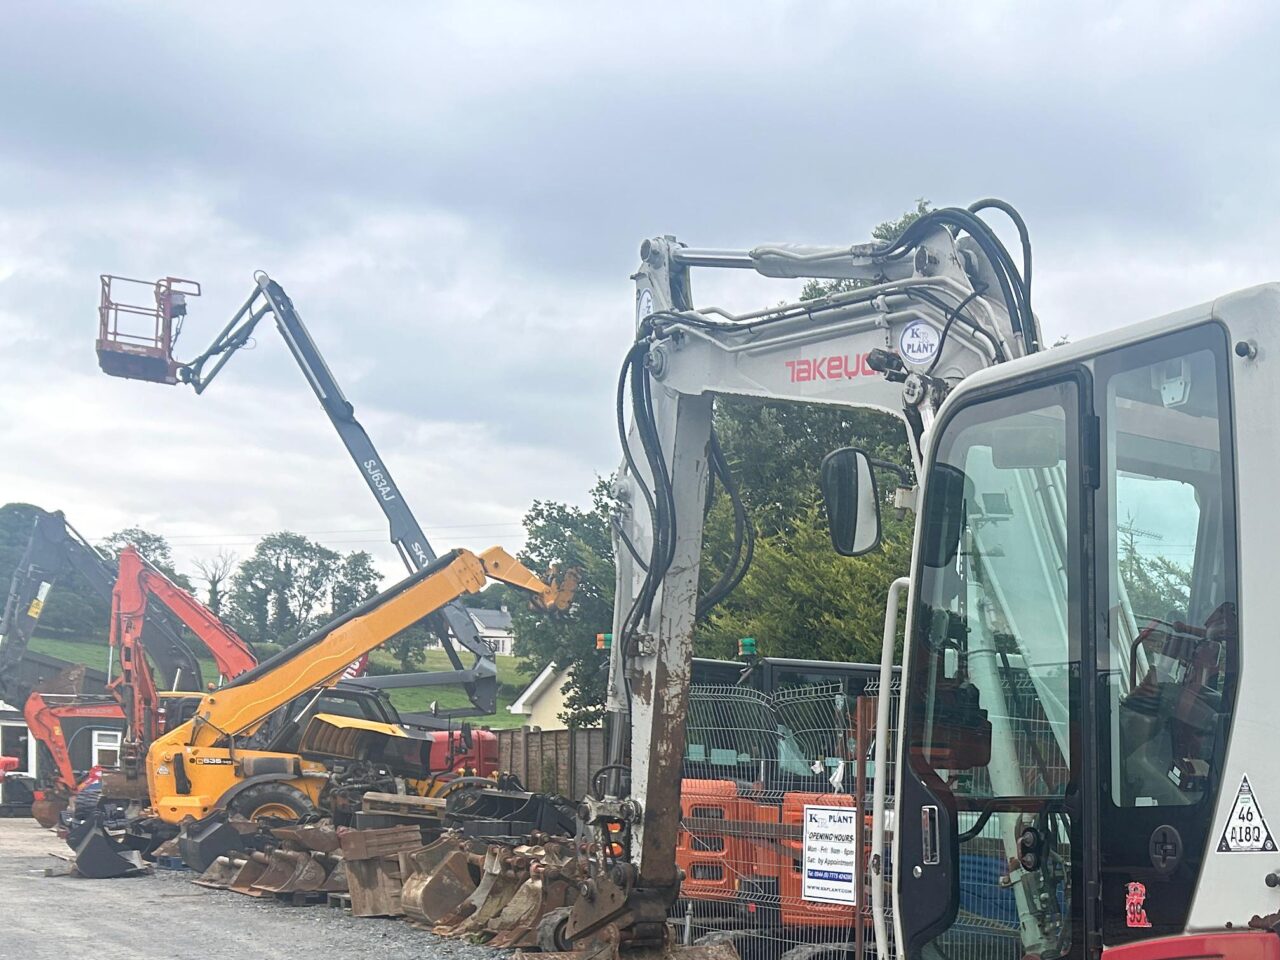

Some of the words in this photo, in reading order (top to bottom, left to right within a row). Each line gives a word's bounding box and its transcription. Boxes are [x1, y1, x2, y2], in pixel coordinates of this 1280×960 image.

[907, 344, 934, 353] PLANT
[363, 459, 396, 501] SJ63AJ
[828, 815, 853, 824] PLANT
[1238, 806, 1253, 822] 46
[808, 831, 833, 841] OPENING
[834, 834, 853, 843] HOURS
